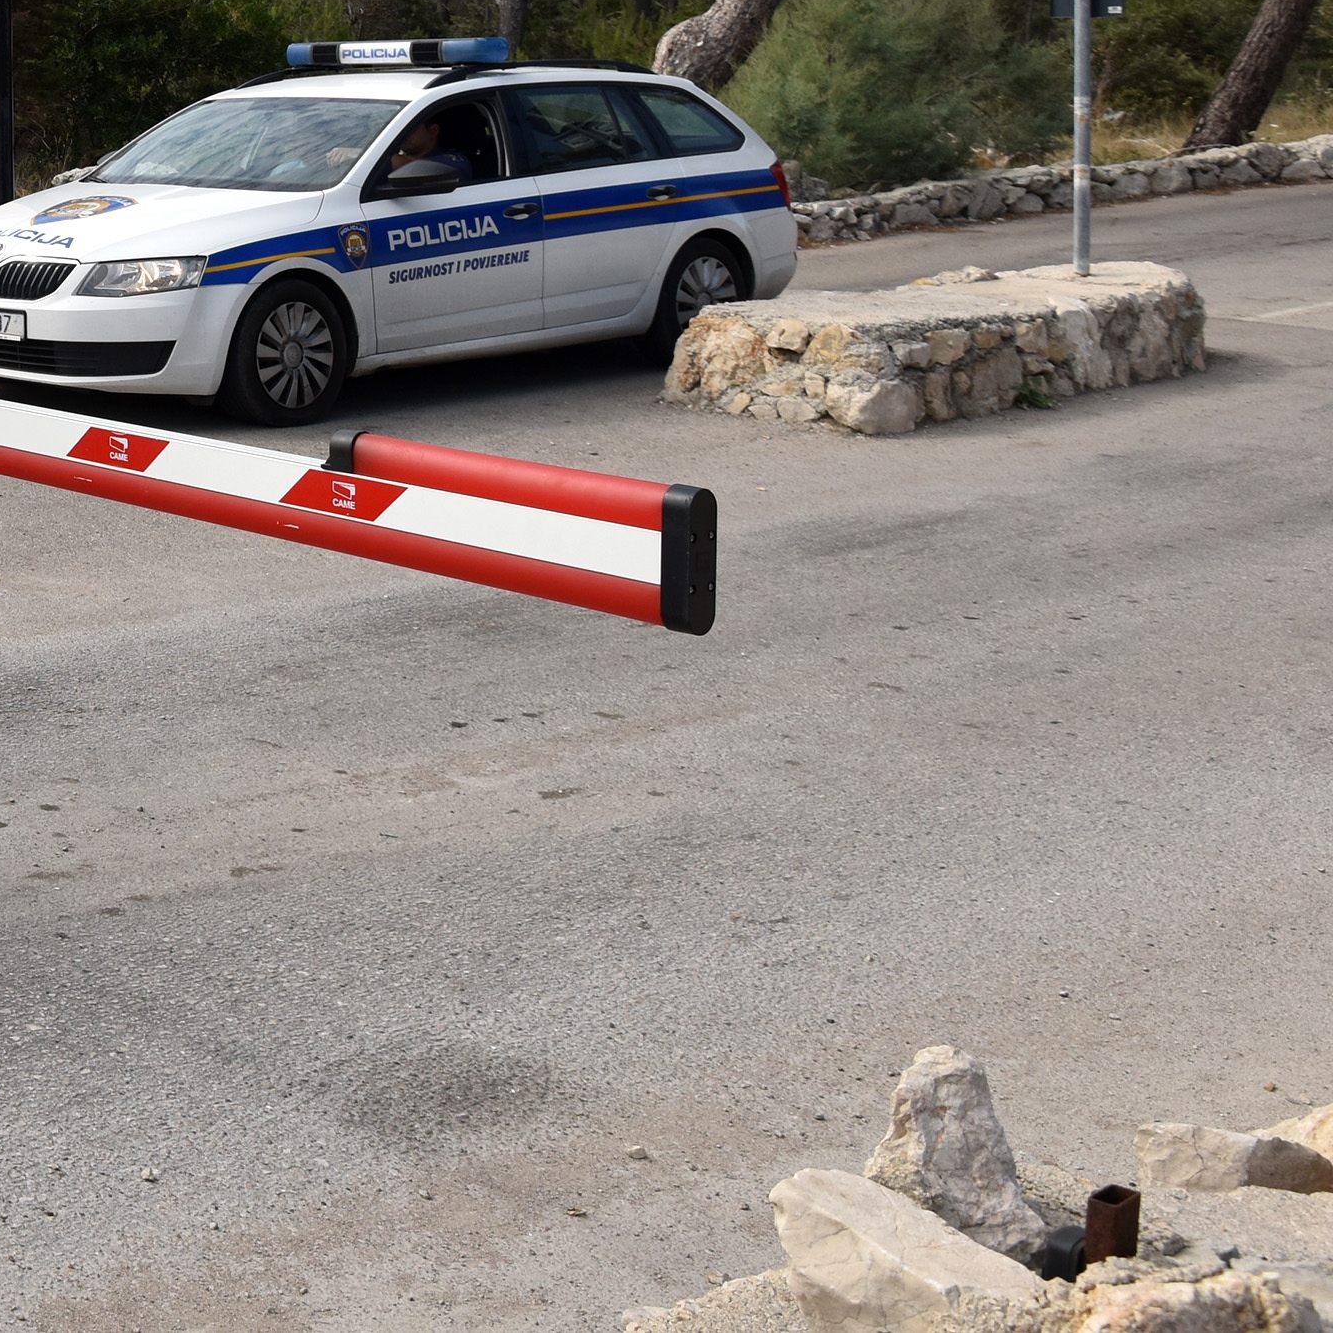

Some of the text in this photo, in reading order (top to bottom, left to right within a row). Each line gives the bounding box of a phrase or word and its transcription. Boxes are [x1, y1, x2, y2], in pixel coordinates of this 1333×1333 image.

[342, 48, 408, 59] POLICIJA
[387, 215, 500, 251] POLICIJA
[388, 250, 530, 284] SIGURNOST I POVJERENJE
[109, 451, 129, 462] CAME
[332, 498, 356, 510] CAME
